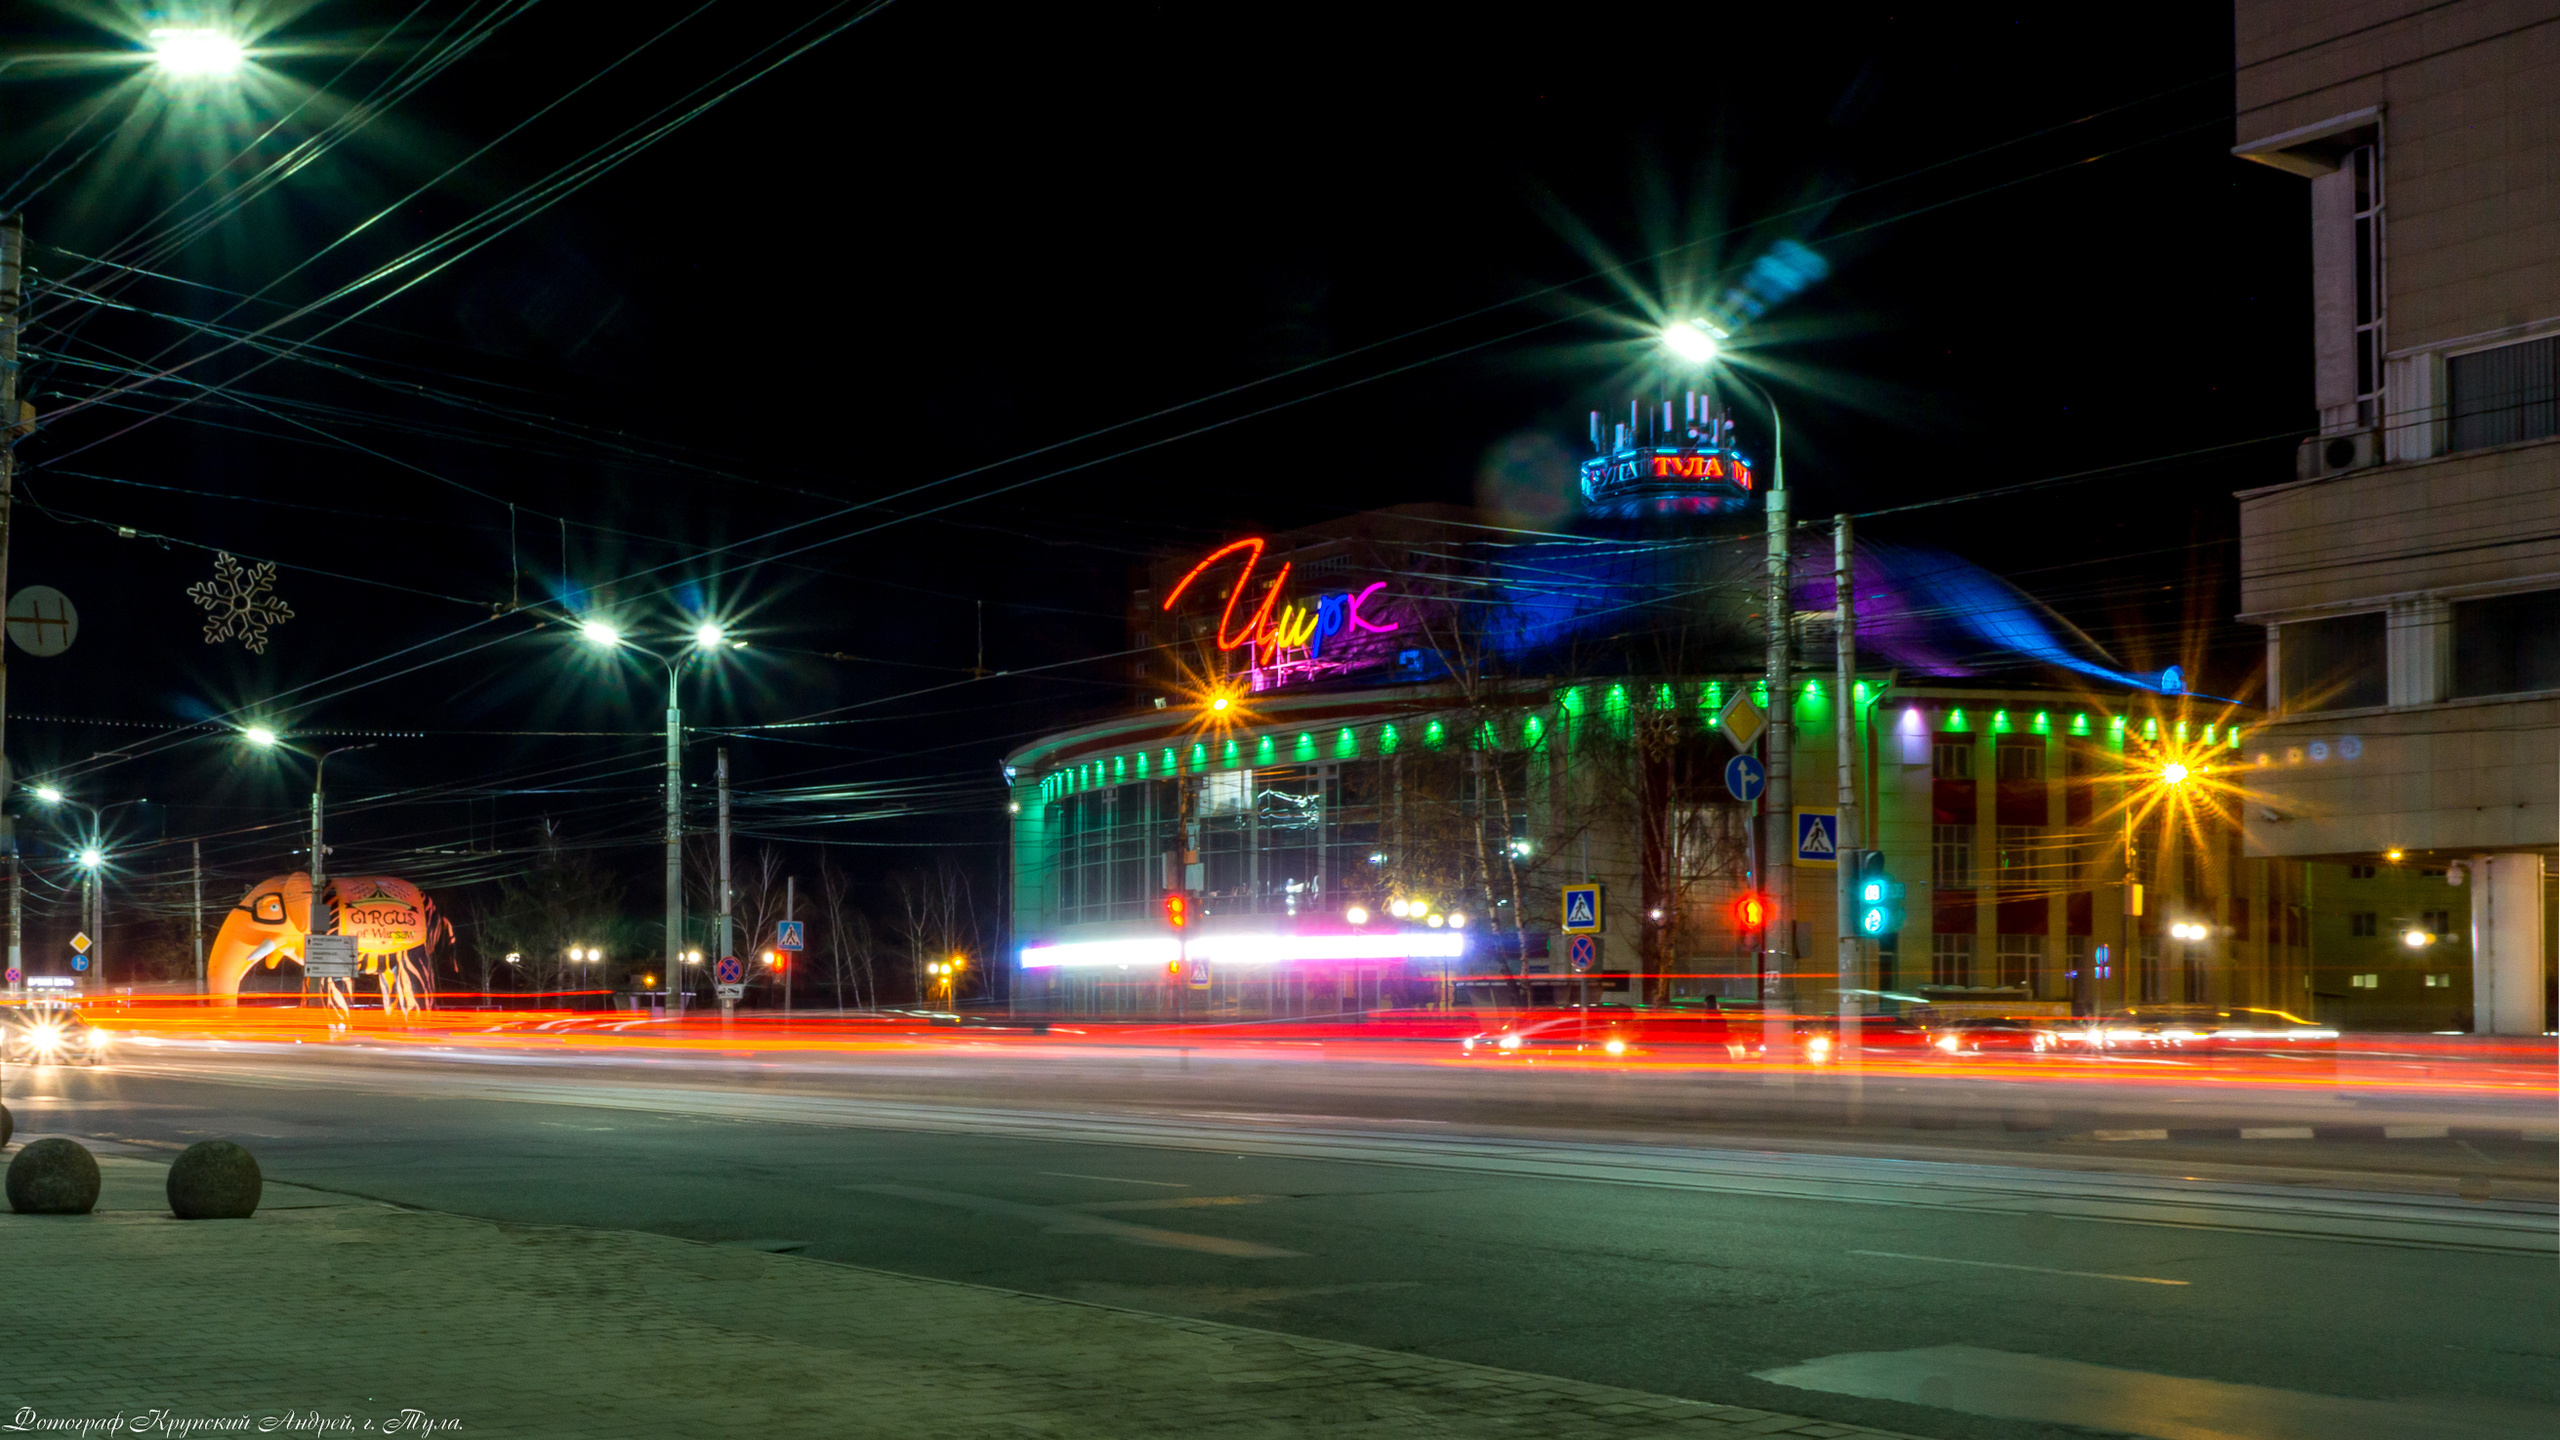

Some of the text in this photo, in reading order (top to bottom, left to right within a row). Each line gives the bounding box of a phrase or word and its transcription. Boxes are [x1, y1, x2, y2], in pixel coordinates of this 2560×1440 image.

[1653, 457, 1724, 477] ТУЛА
[1163, 537, 1399, 666] Цирк
[351, 909, 416, 927] CIRCUS
[357, 928, 416, 939] of Warsaw
